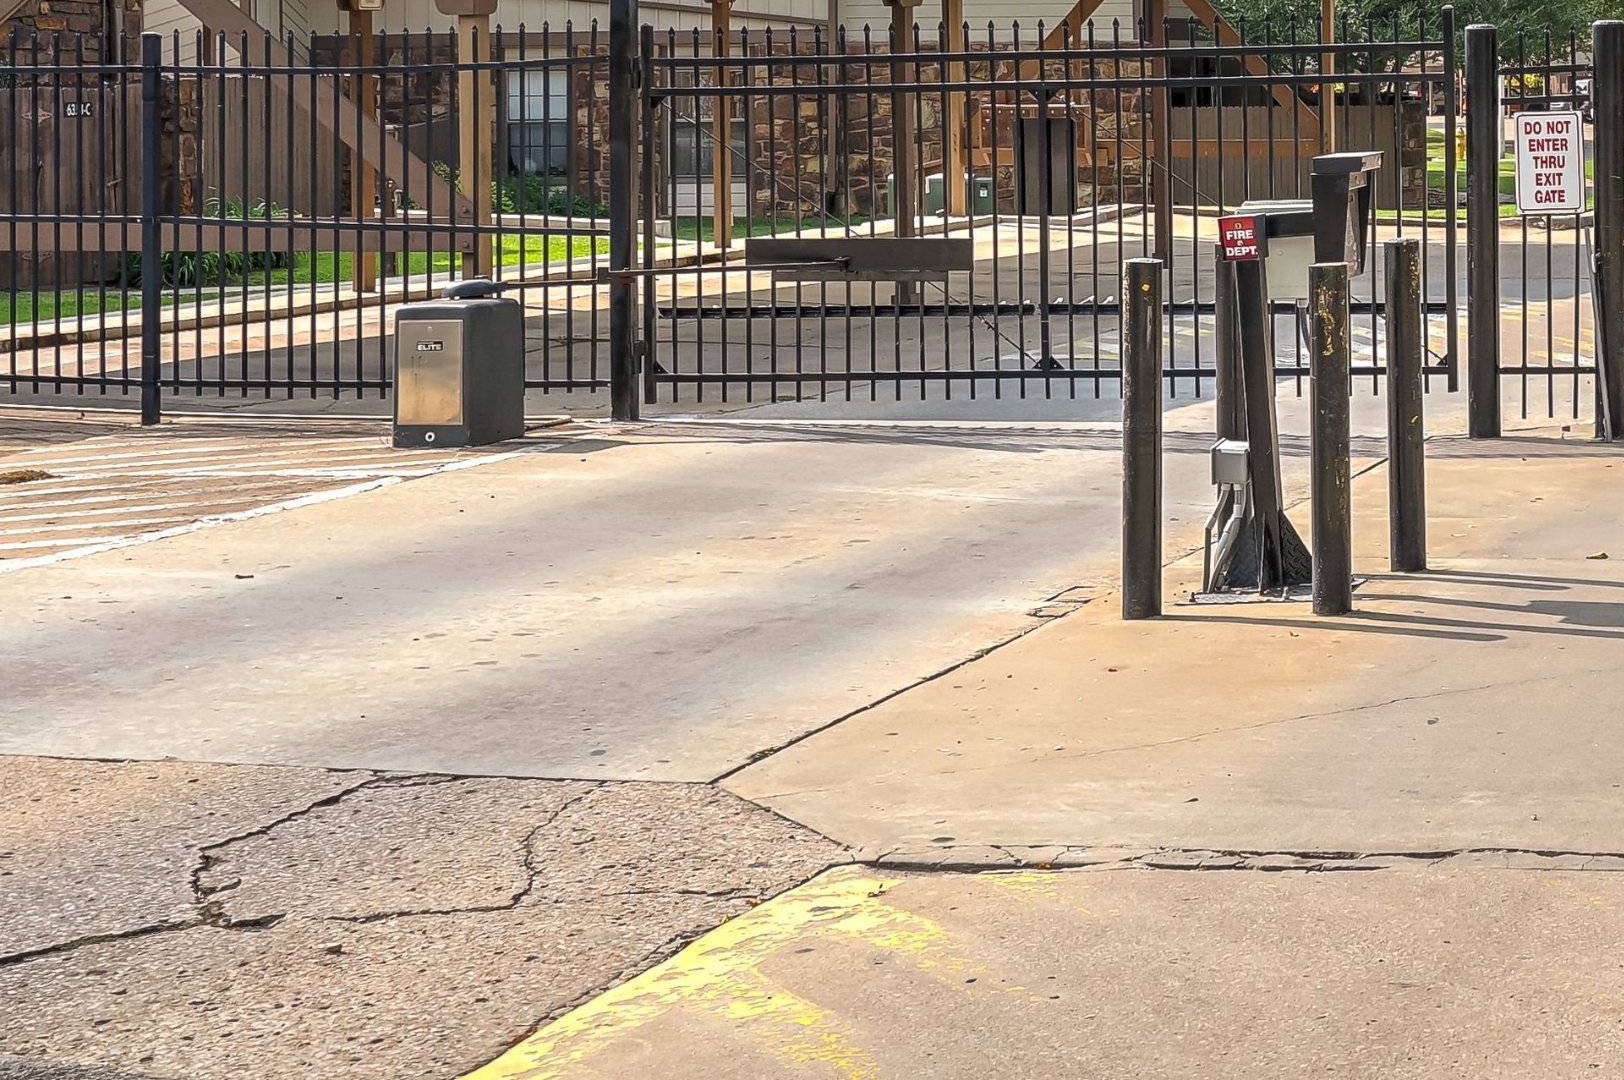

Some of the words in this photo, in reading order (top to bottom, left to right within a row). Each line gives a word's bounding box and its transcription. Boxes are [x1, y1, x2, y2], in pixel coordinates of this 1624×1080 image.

[1524, 121, 1542, 135] DO
[1546, 121, 1571, 134] NOT
[1528, 138, 1568, 152] ENTER
[1532, 156, 1566, 169] THRU
[1535, 173, 1563, 186] EXIT
[1534, 190, 1566, 204] GATE
[1226, 230, 1254, 240] FIRE
[1226, 246, 1258, 257] DEPT.
